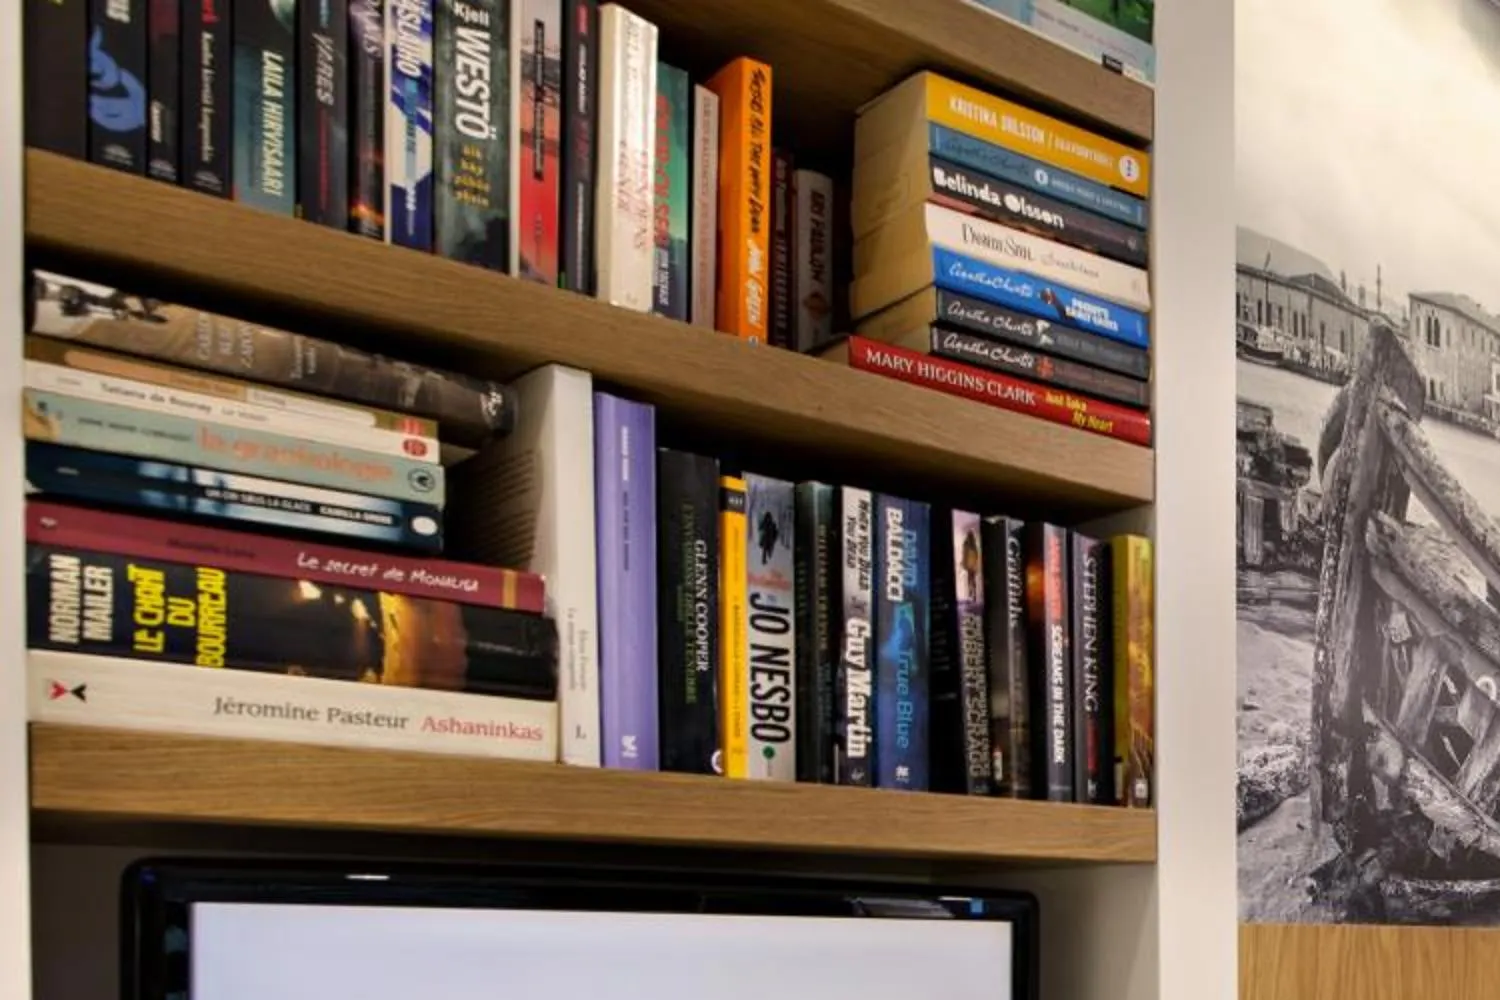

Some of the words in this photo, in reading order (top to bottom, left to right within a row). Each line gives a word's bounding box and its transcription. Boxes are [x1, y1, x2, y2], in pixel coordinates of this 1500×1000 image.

[261, 50, 284, 98] LAILA
[455, 26, 497, 140] WESTÖ
[261, 99, 285, 198] HIRVISAARI
[932, 166, 1001, 207] Belinda
[1003, 194, 1065, 230] Olsson
[866, 346, 915, 374] MARY
[917, 358, 985, 393] HIGGINS
[986, 378, 1037, 407] CLARK
[296, 551, 322, 571] Le
[325, 557, 378, 577] secret
[383, 566, 406, 582] de
[695, 538, 708, 599] GLENN
[885, 506, 904, 603] BALDACCI
[49, 553, 81, 644] NORMAN
[82, 565, 113, 642] MAILER
[127, 563, 165, 626] CHANT
[167, 596, 196, 628] DU
[195, 567, 227, 669] BOURREAU
[749, 593, 790, 634] JO
[1082, 552, 1099, 652] STEPHEN
[133, 630, 164, 653] LE
[695, 600, 709, 672] COOPER
[844, 615, 872, 668] Guy
[962, 614, 979, 691] ROBERT
[1050, 623, 1066, 686] SCREAMS
[895, 648, 915, 696] True
[1051, 687, 1065, 702] IN
[1083, 656, 1100, 712] KING
[214, 695, 320, 722] Jéromine
[325, 704, 410, 730] Pasteur
[420, 714, 544, 742] Ashaninkas
[846, 668, 872, 759] Martin
[895, 699, 915, 749] Blue
[1052, 703, 1065, 728] THE
[1052, 729, 1066, 764] DARK
